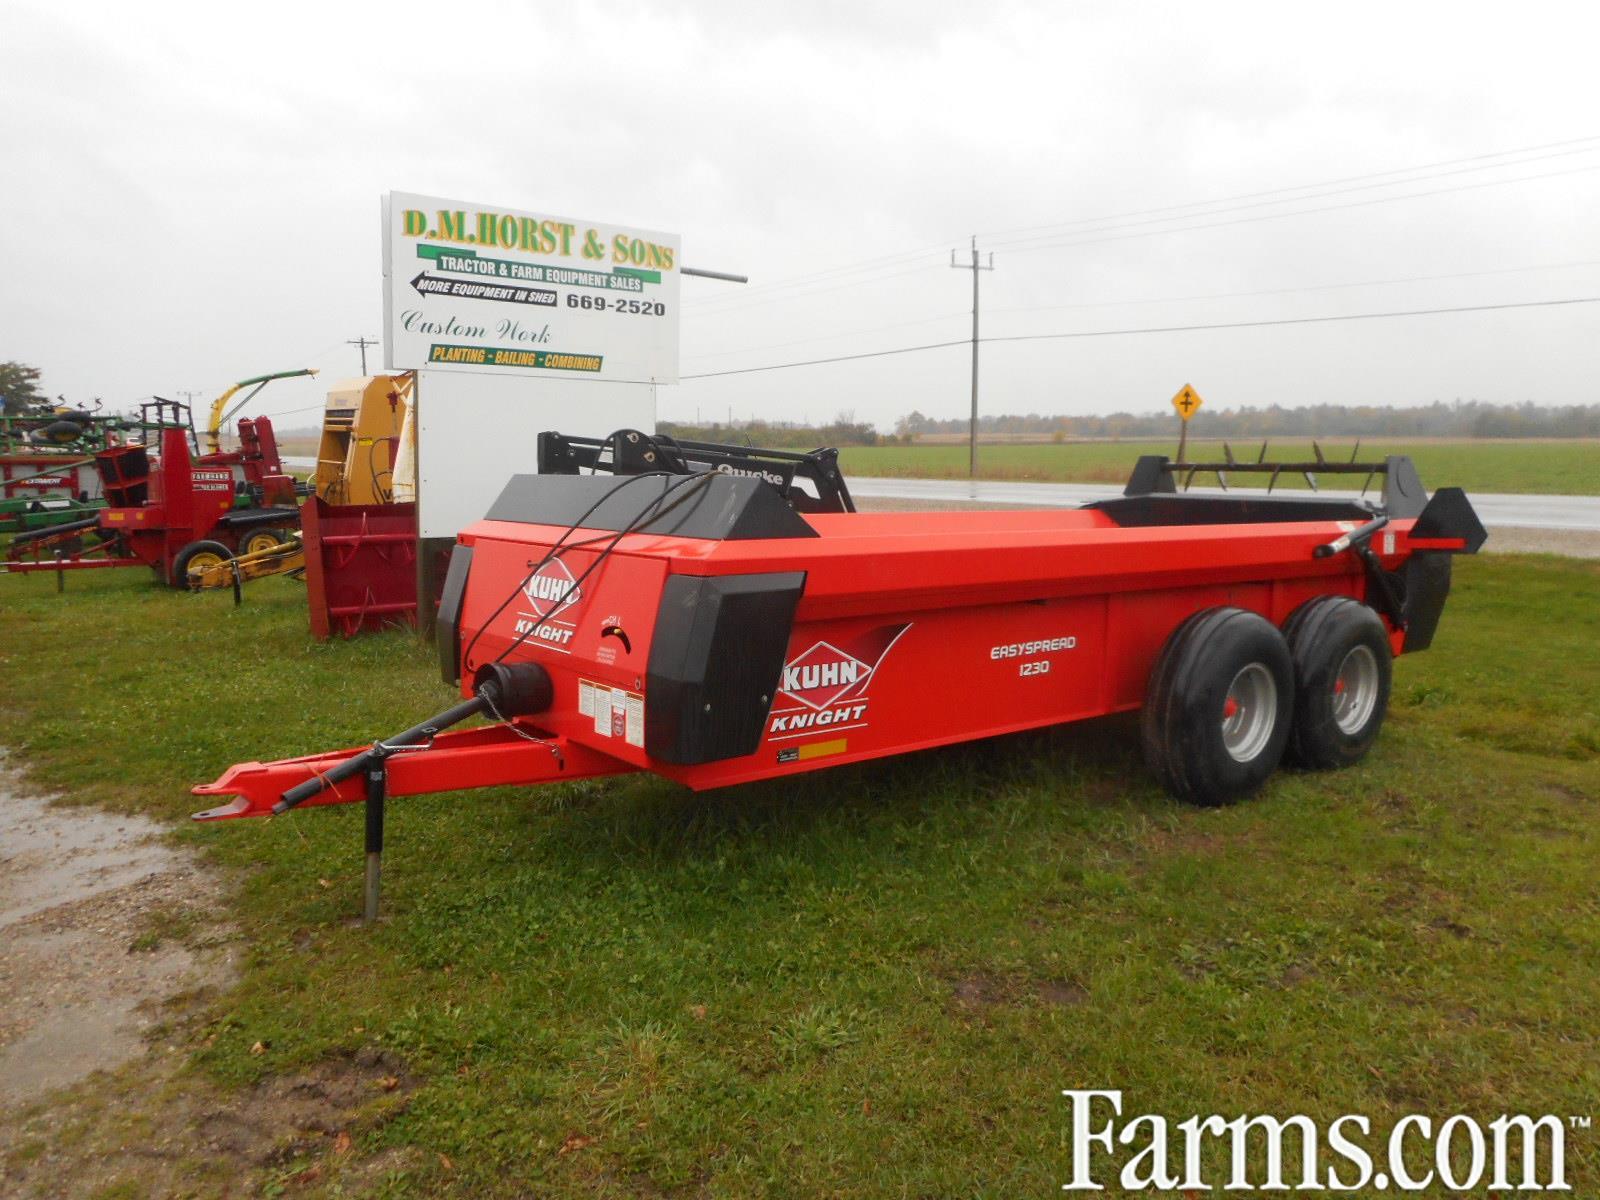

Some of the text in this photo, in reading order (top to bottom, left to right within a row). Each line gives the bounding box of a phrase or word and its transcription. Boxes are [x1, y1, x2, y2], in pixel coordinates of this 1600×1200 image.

[582, 229, 605, 260] &
[612, 233, 674, 271] SONS
[441, 256, 641, 290] TRACTOR & FARM EQUIPMENT SALES
[417, 279, 557, 304] MORE EQUIPMENT IN SHED
[567, 294, 666, 316] 669-2520
[400, 309, 552, 344] Custom Work
[432, 347, 486, 363] PLANTING
[495, 351, 536, 366] BAILING
[545, 354, 601, 371] COMBINING
[528, 575, 578, 605] KUHN
[515, 619, 574, 644] KNIGHT
[990, 636, 1076, 660] EASYSPREAD
[783, 660, 857, 692] KUHN
[1019, 660, 1050, 677] 1230
[770, 704, 868, 734] KNIGHT
